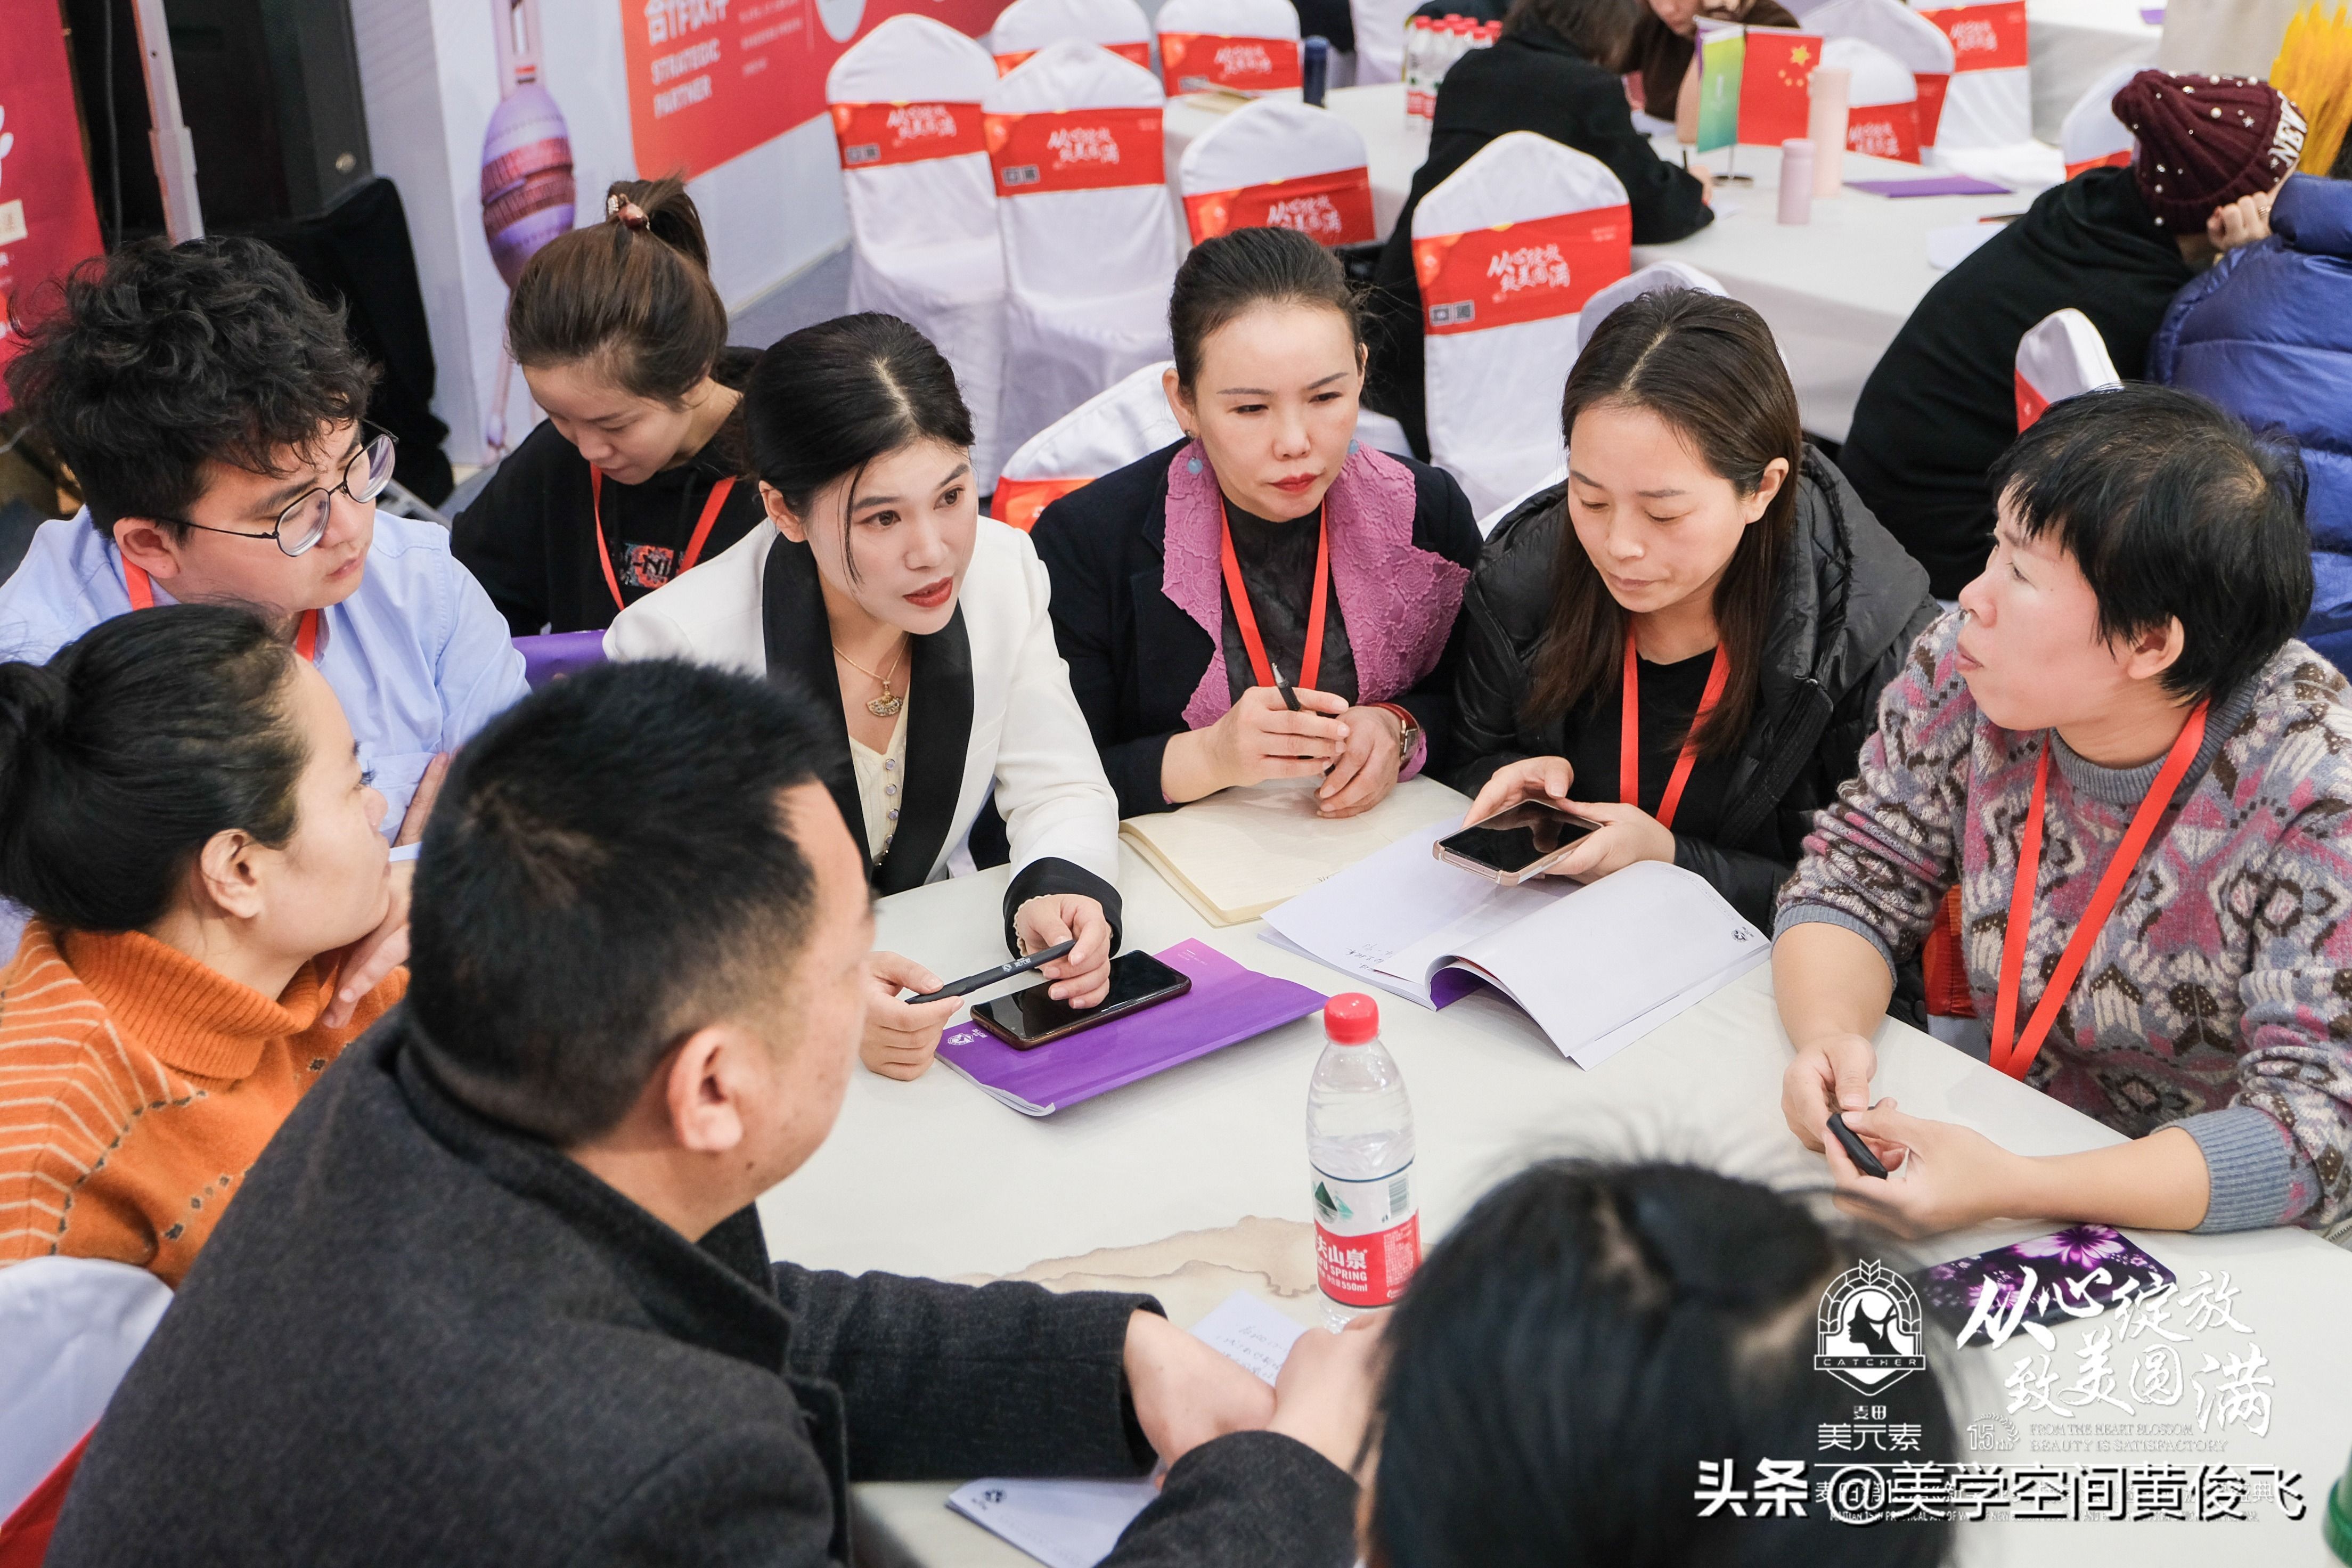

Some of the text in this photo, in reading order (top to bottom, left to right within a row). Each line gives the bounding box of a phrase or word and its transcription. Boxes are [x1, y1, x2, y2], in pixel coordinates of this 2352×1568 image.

[1316, 1233, 1367, 1270] 夫山泉
[1329, 1265, 1368, 1282] SPRING
[1341, 1281, 1368, 1292] 550ml
